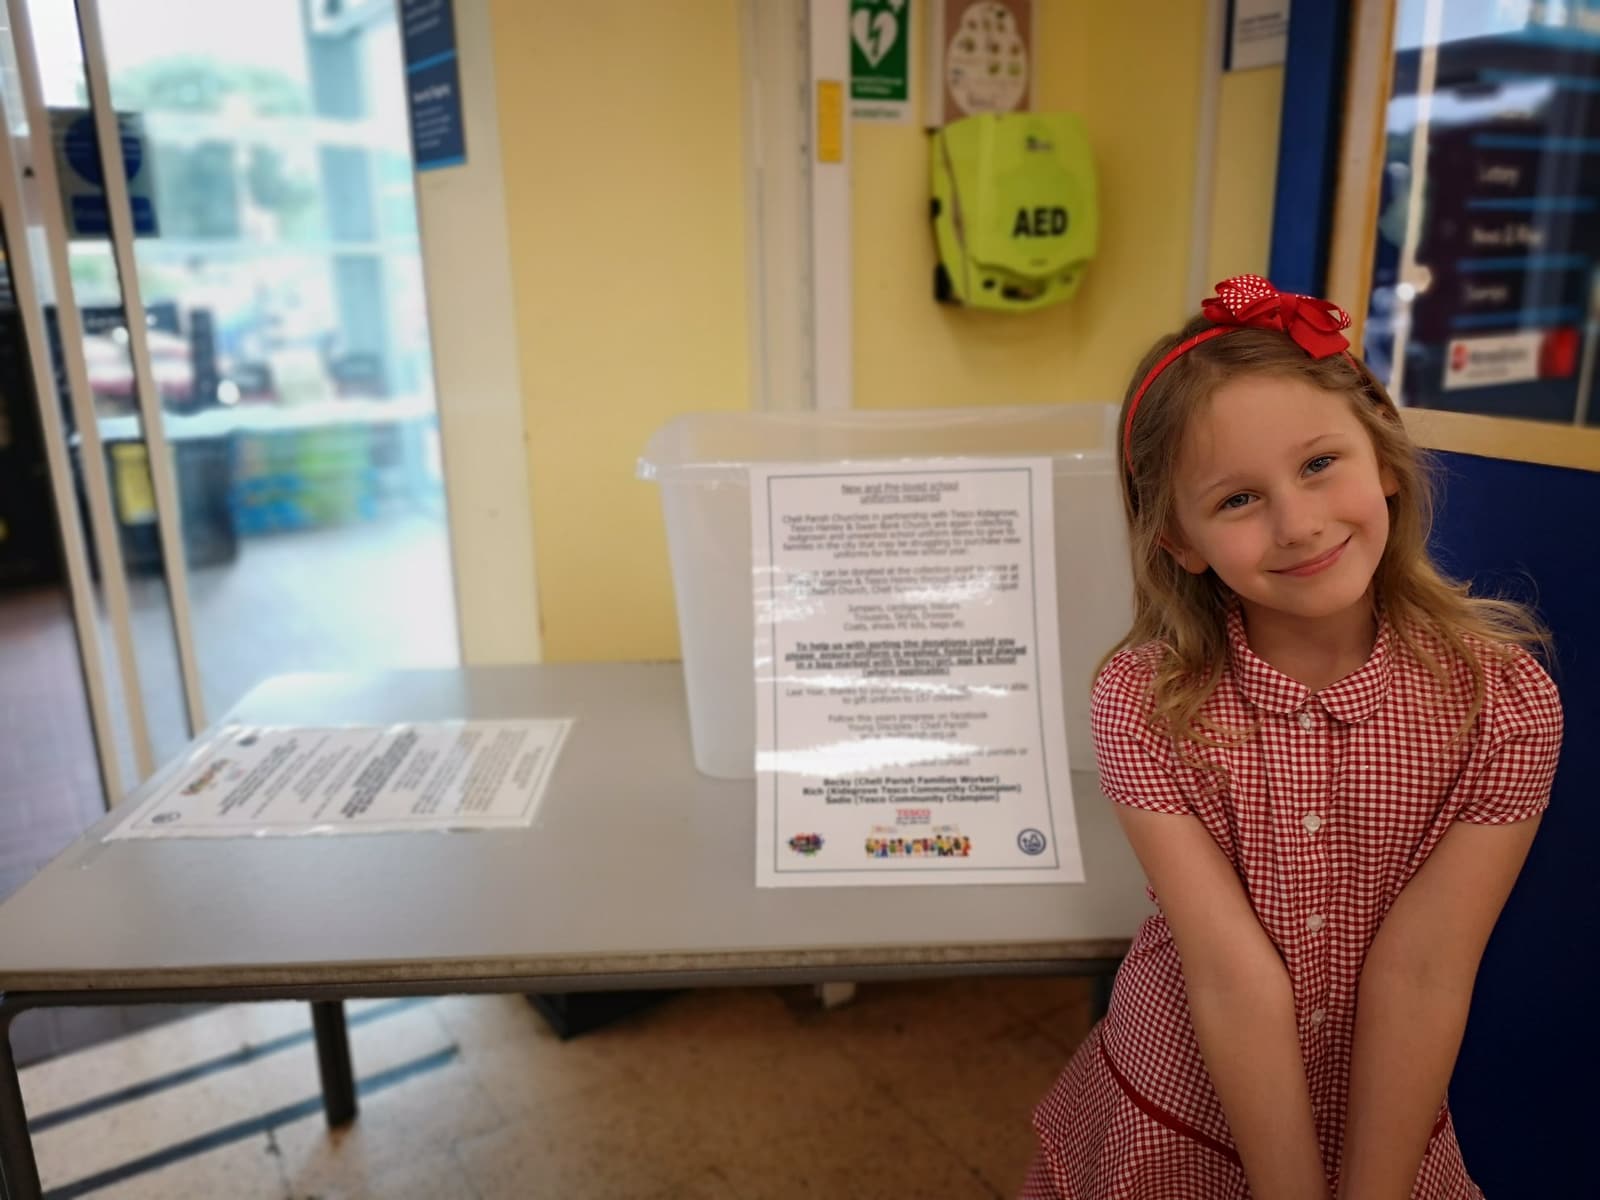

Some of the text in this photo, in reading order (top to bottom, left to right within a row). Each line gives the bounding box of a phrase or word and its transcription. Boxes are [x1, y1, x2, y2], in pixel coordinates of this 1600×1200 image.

[1012, 206, 1069, 238] AED
[824, 775, 999, 787] Becky (Chell Parish Families Worker)
[803, 784, 1021, 797] Rich (Kidsgrove Tesco Community Champion)
[855, 796, 886, 805] (Tesco
[889, 795, 943, 804] Community
[947, 794, 999, 803] Champion)
[896, 808, 931, 817] TESCO
